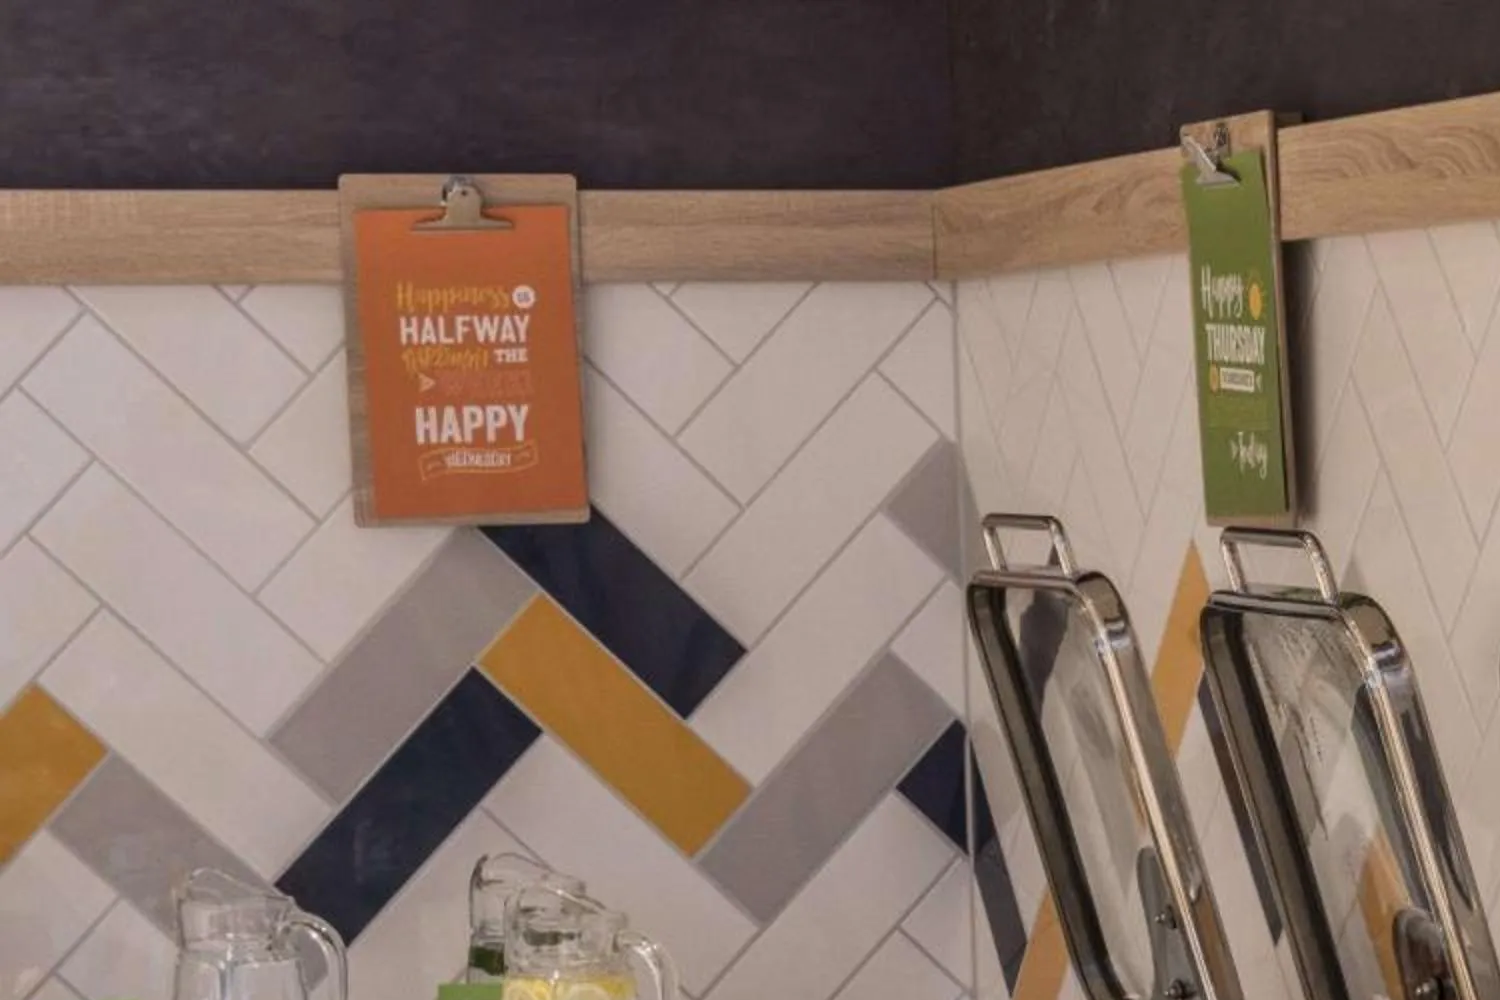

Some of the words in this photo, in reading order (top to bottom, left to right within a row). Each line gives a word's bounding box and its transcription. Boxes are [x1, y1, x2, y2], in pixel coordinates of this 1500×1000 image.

[397, 280, 511, 314] Happiness
[1201, 265, 1245, 317] Happy
[400, 314, 530, 345] HALFWAY
[1205, 323, 1266, 364] THURSDAY
[494, 348, 529, 363] THE
[415, 403, 530, 444] HAPPY
